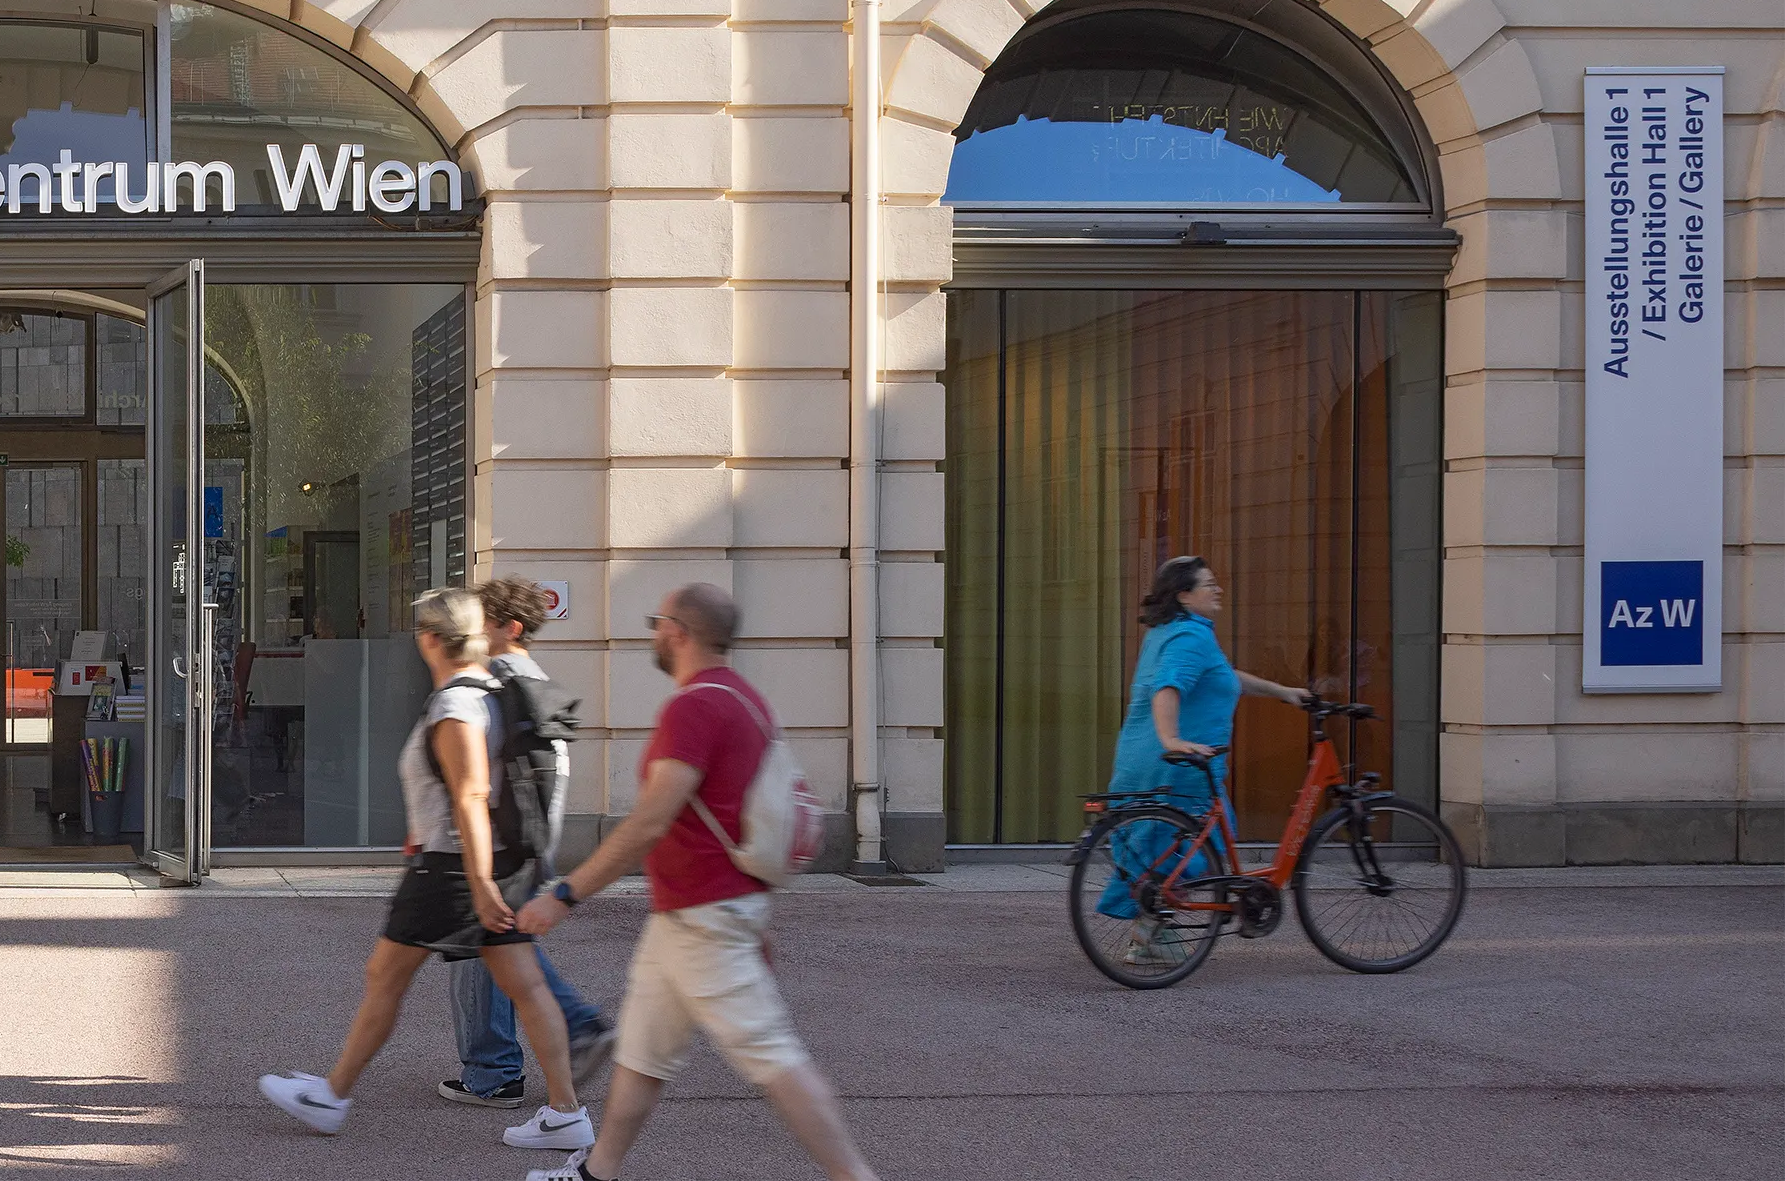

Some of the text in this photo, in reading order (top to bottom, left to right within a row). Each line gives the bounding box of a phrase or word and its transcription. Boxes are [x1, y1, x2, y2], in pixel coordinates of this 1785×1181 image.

[266, 142, 463, 214] Wien
[1678, 86, 1709, 194] Gallery
[1604, 88, 1635, 378] Ausstellungshalle 1
[1642, 88, 1666, 341] / Exhibition Hall 1
[1678, 214, 1703, 324] Galerie
[1608, 599, 1695, 628] Az W
